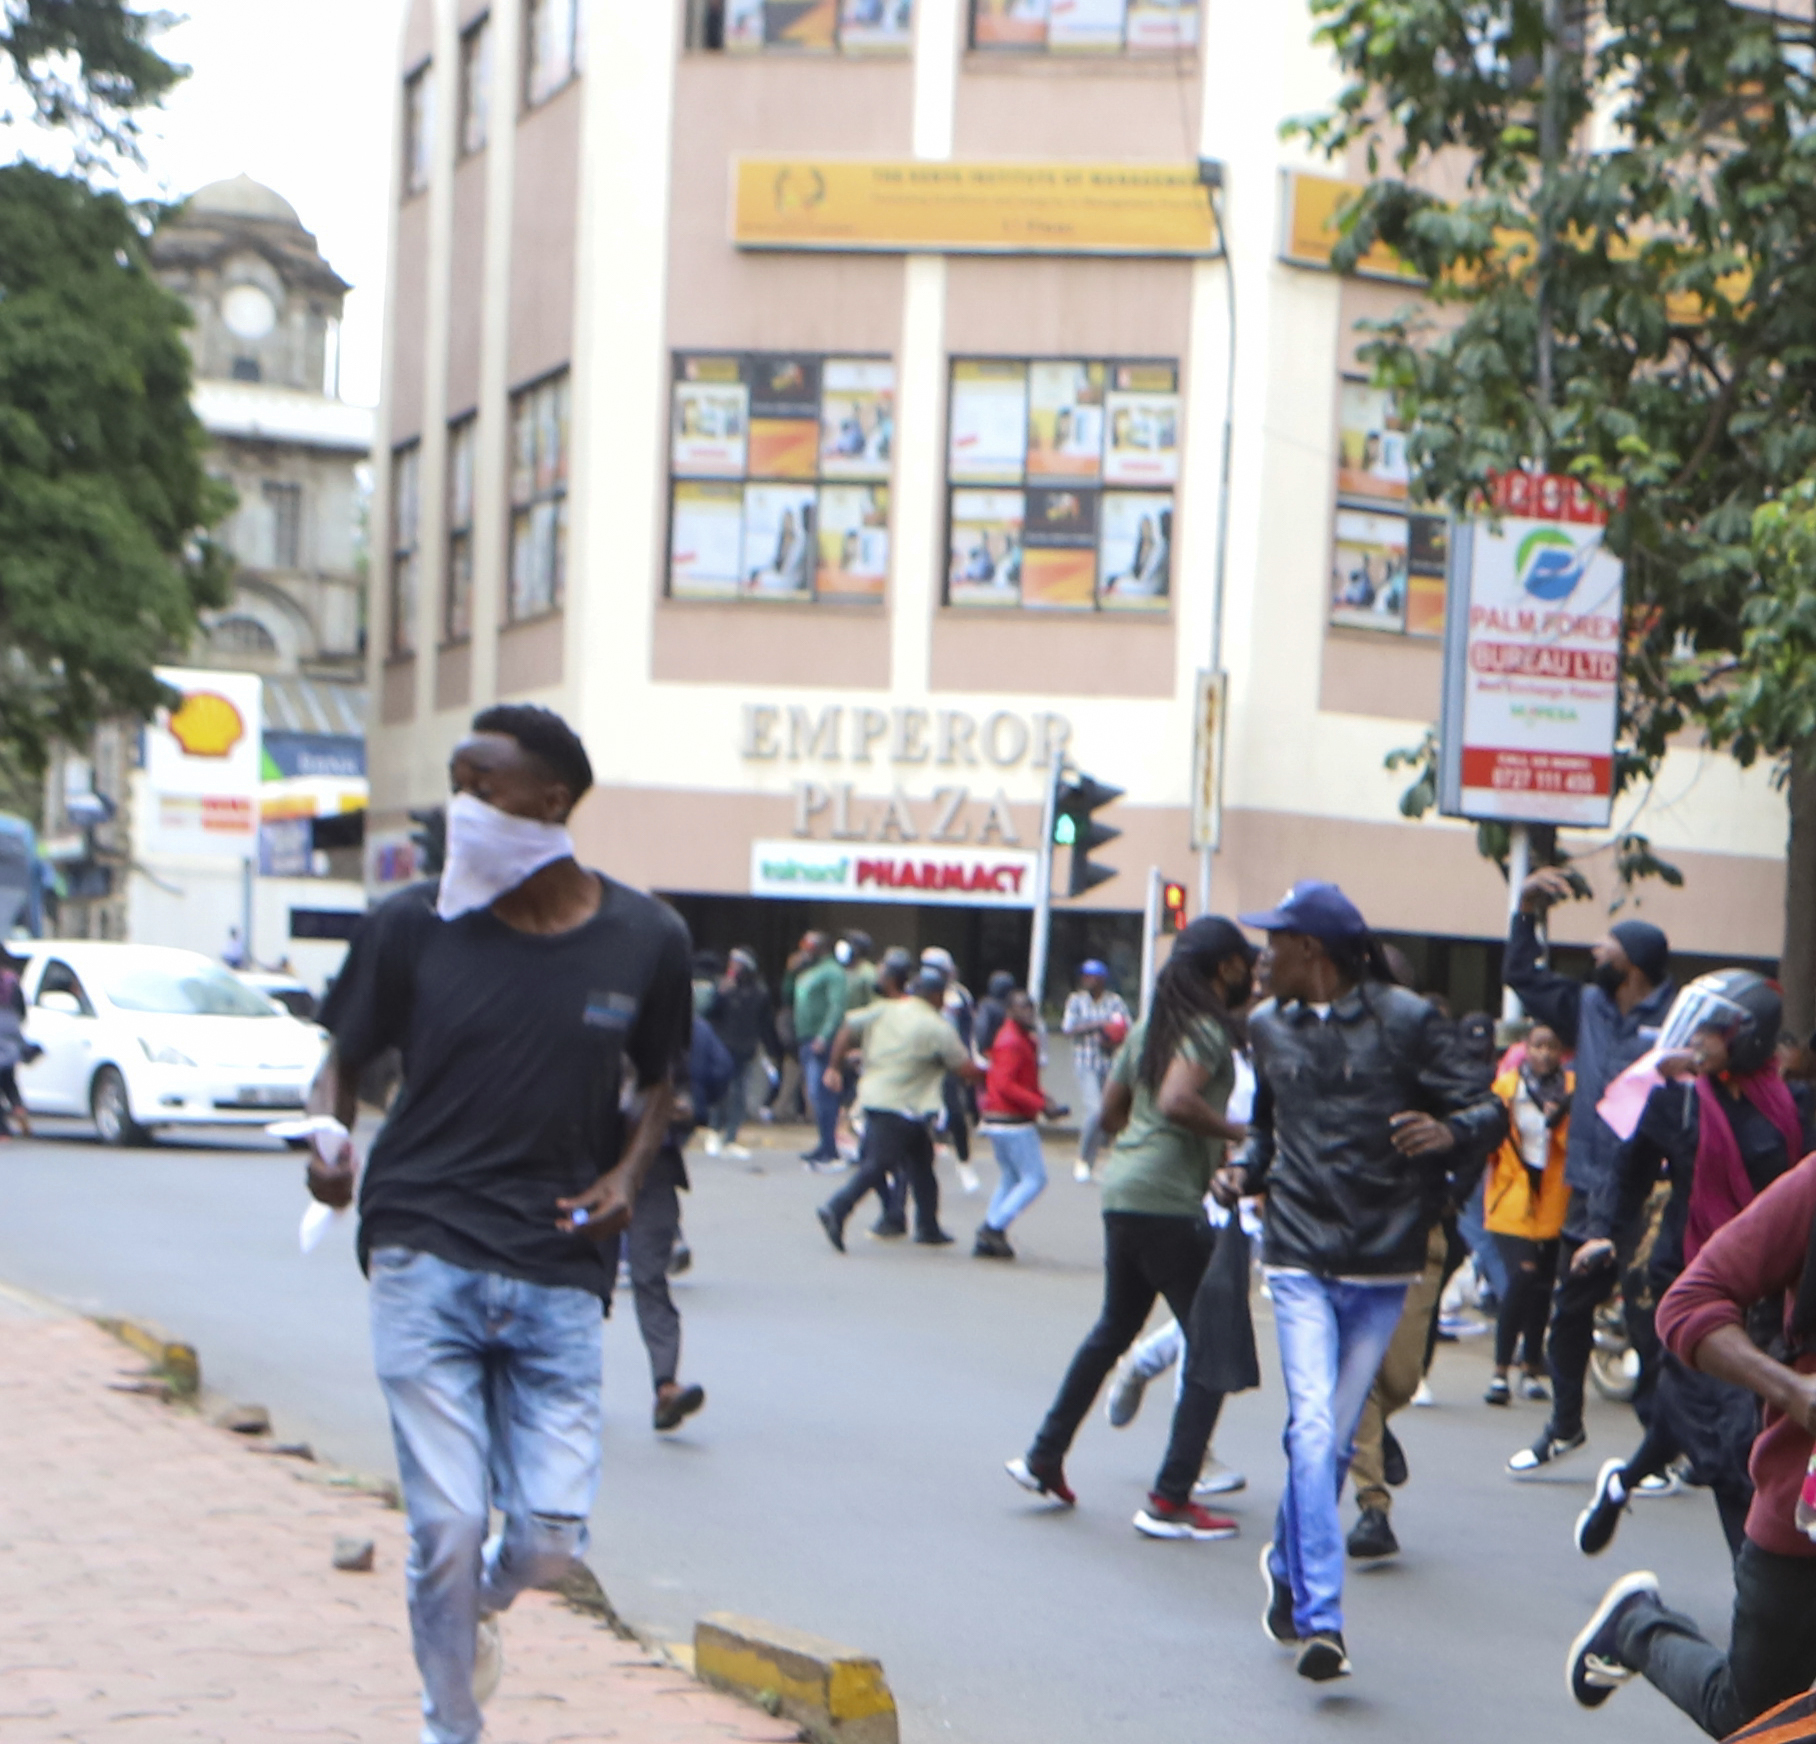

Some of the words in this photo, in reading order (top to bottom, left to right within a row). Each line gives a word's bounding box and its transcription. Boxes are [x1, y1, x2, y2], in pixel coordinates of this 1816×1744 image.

[741, 703, 1074, 768] EMPEROR
[792, 781, 1020, 845] PLAZA
[857, 858, 1026, 893] PHARMACY
